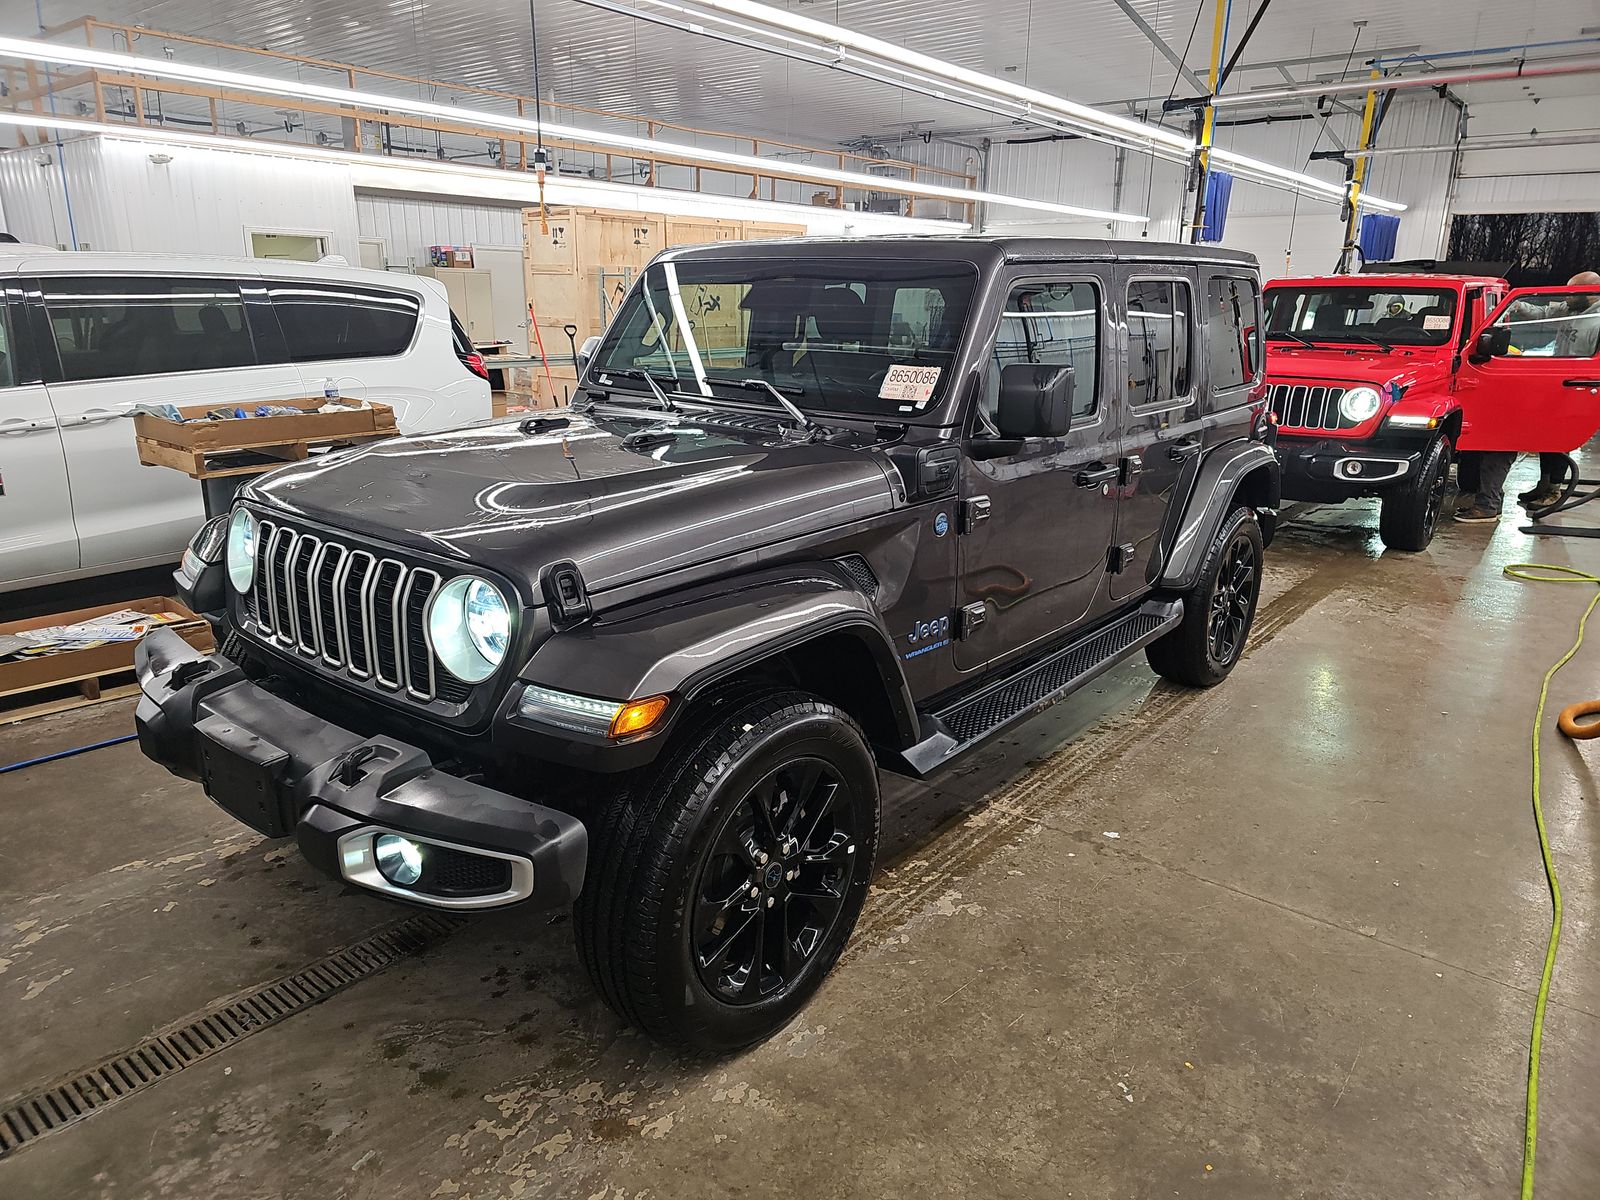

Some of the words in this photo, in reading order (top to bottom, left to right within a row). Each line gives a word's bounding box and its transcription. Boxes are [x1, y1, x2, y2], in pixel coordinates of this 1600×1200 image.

[889, 369, 938, 385] 8650086
[907, 616, 949, 644] Jeep
[905, 641, 943, 660] WRANGLER
